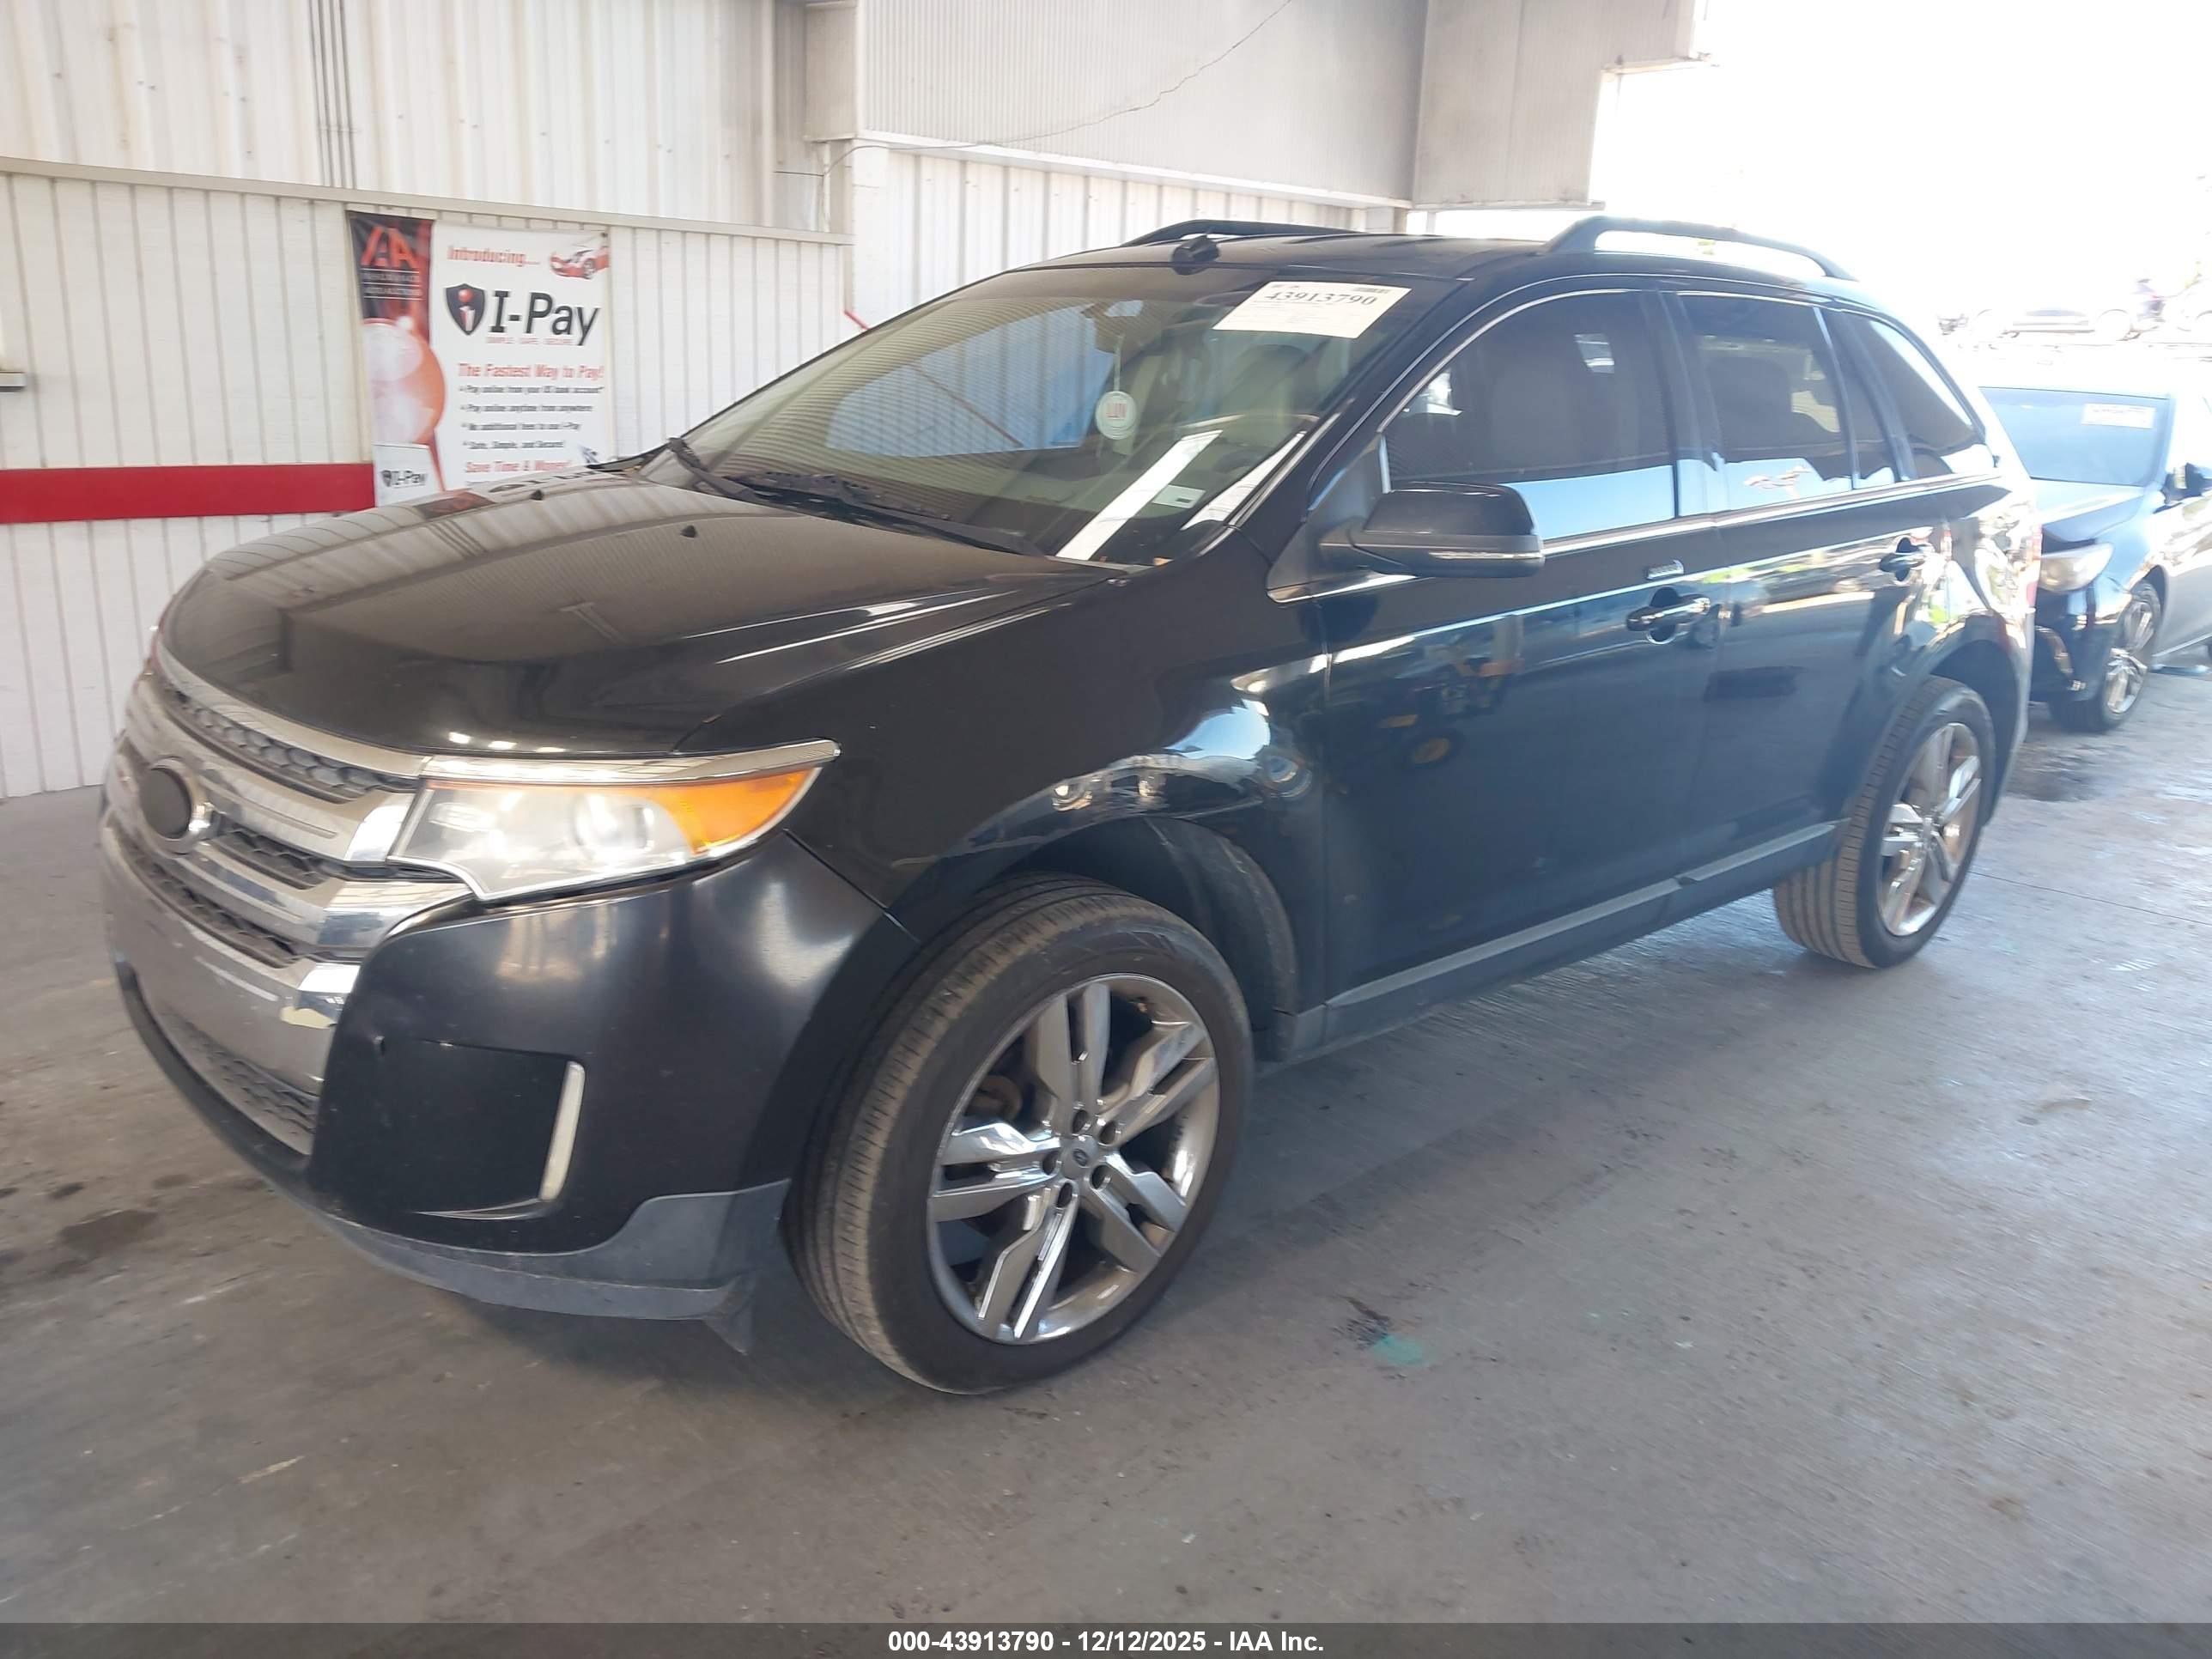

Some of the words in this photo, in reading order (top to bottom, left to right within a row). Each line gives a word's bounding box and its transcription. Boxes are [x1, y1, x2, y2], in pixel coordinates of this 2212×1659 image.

[1265, 290, 1378, 306] 43913790
[490, 290, 600, 346] I-Pay
[458, 362, 481, 377] The
[484, 363, 531, 378] Fastest
[535, 364, 559, 380] Way
[562, 366, 574, 378] to
[494, 460, 520, 472] Time
